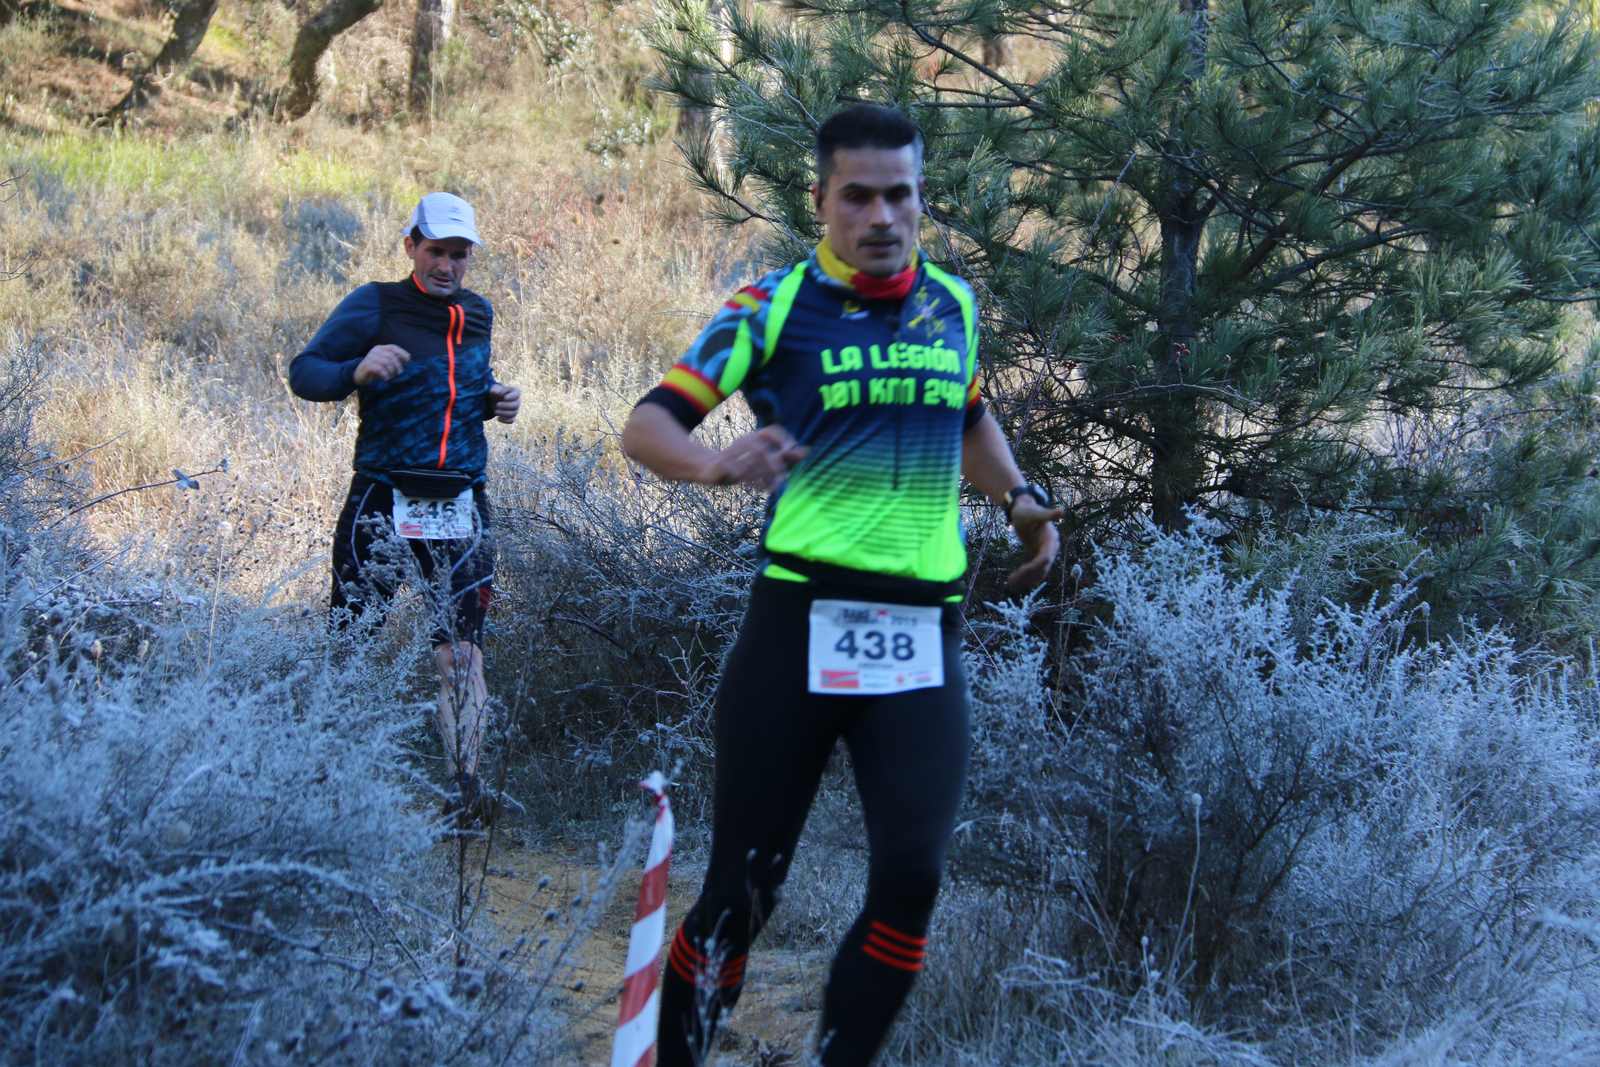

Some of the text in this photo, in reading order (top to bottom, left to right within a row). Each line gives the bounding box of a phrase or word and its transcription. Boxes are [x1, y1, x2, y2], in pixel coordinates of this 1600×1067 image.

[821, 345, 864, 375] LA
[818, 379, 861, 412] 101
[834, 629, 916, 662] 438
